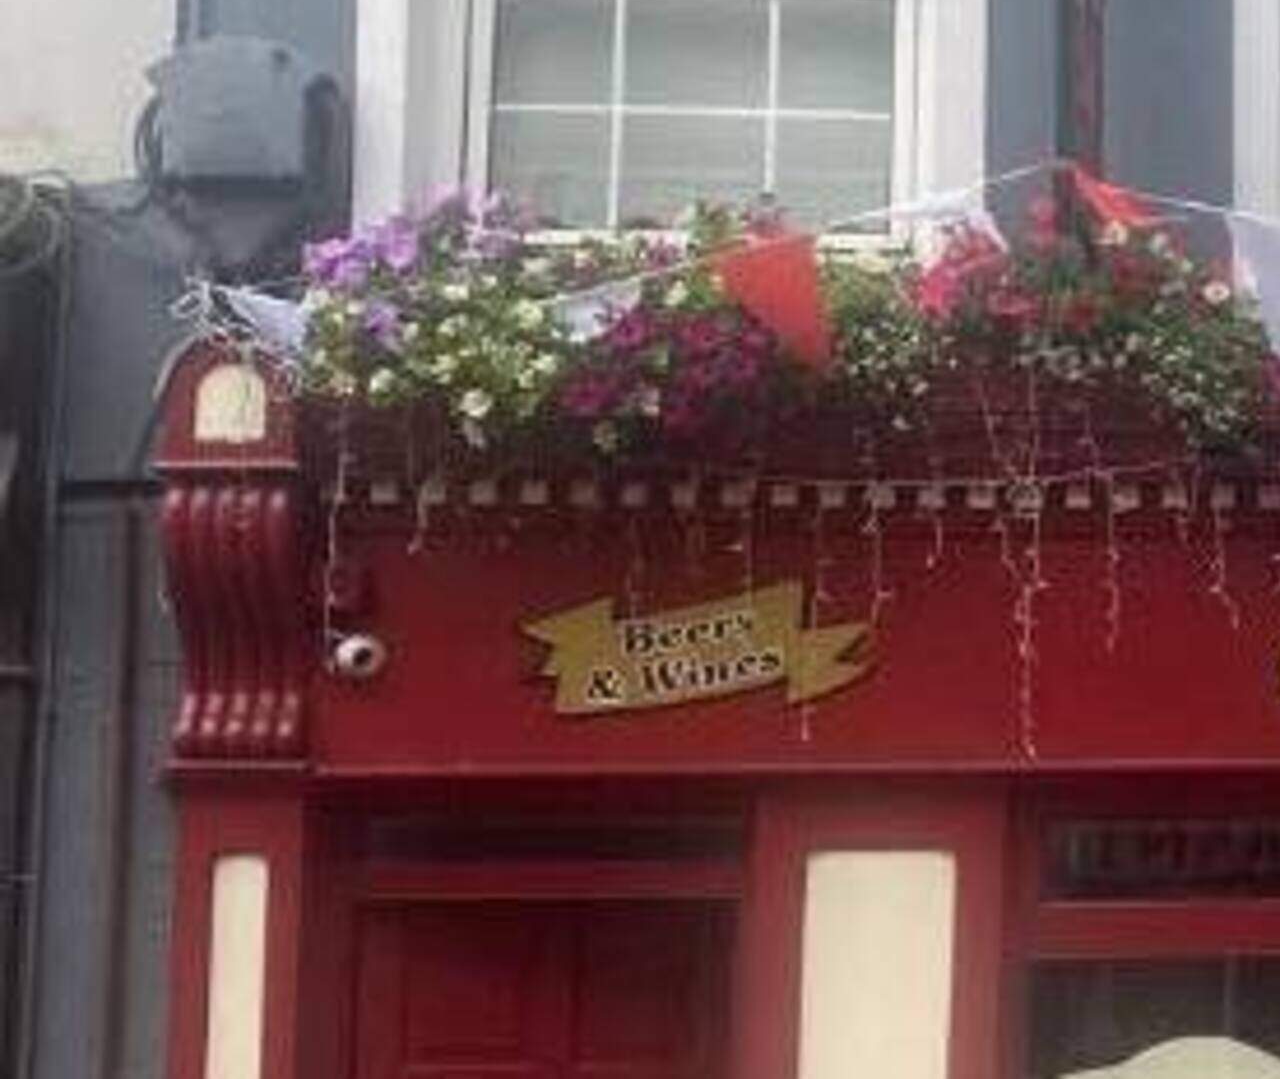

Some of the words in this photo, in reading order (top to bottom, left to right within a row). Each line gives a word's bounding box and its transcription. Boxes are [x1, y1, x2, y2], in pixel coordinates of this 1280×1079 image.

[625, 611, 753, 655] Beers
[586, 669, 622, 702] &
[642, 648, 784, 694] Wines
